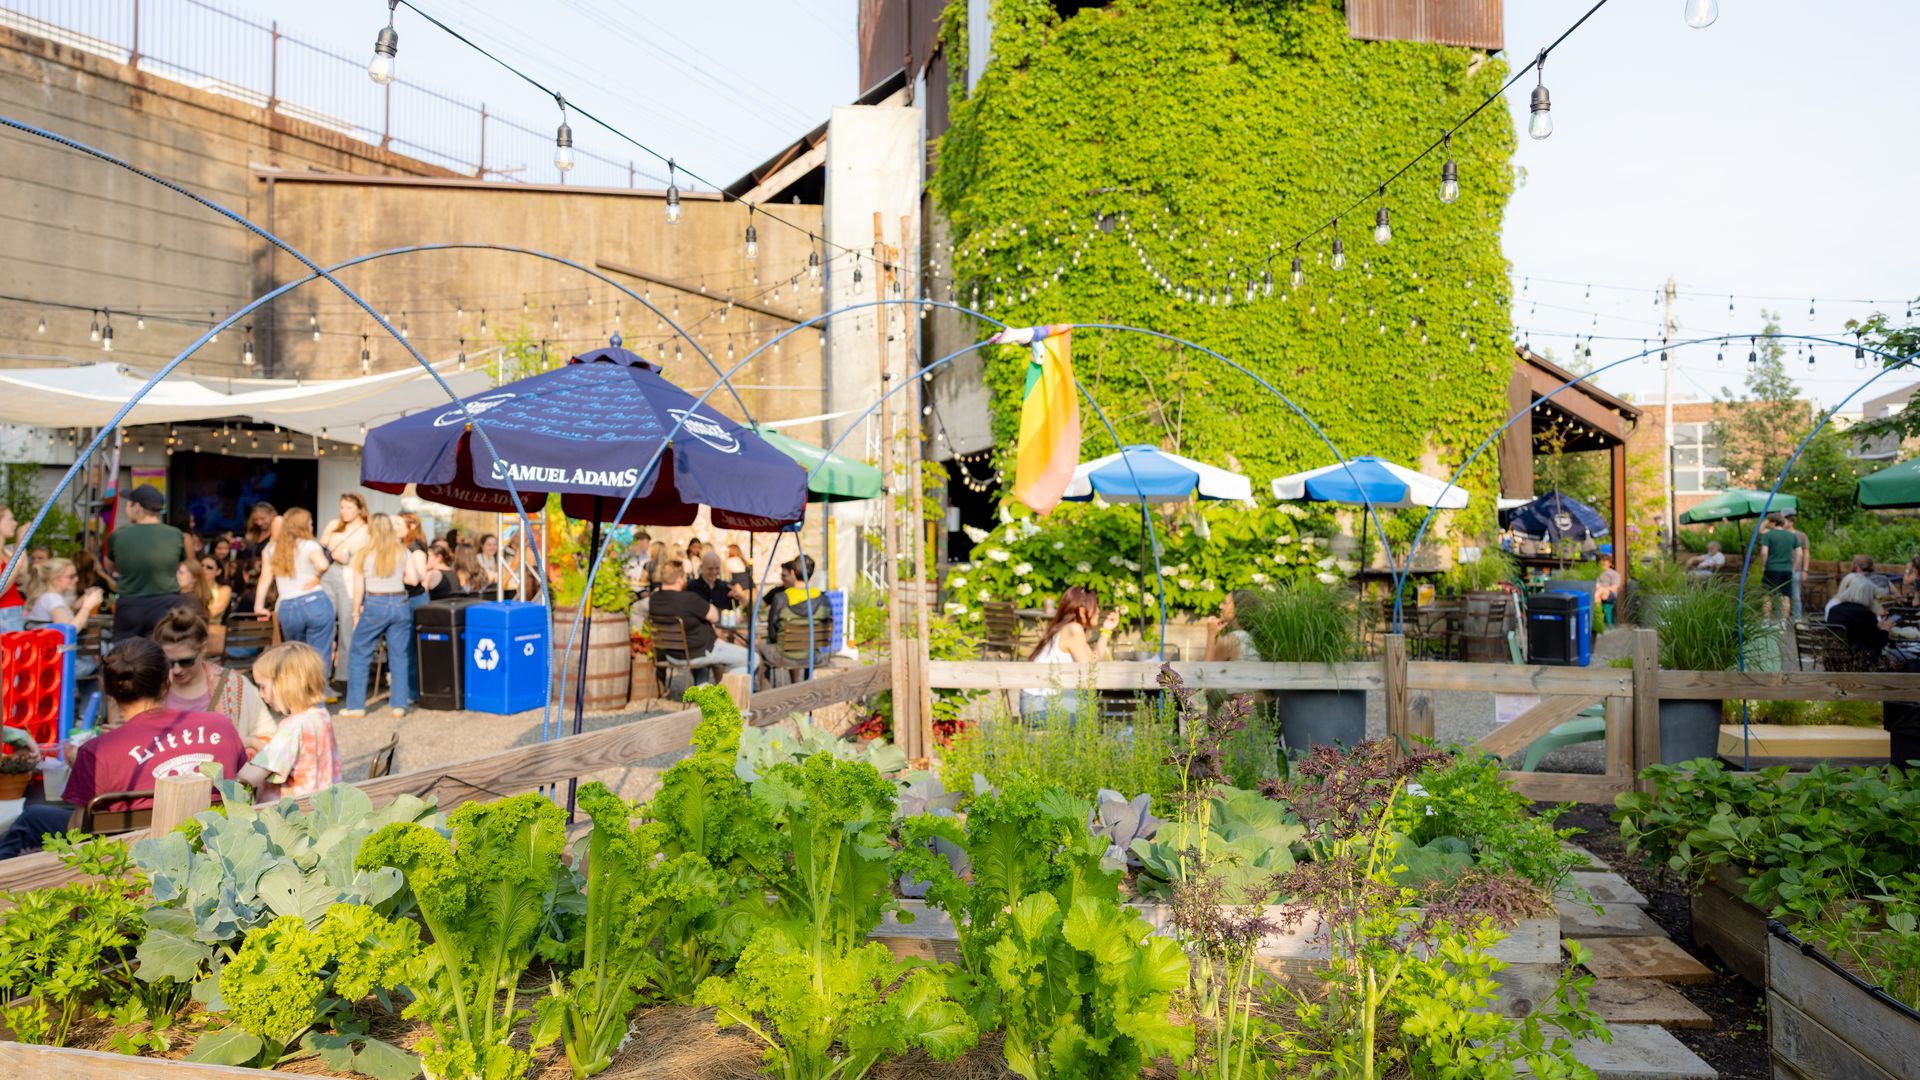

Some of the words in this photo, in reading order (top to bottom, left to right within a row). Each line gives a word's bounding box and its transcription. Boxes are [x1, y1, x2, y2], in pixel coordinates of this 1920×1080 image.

[491, 459, 569, 484] SAMUEL
[571, 468, 638, 487] ADAMS
[128, 726, 221, 765] Little
